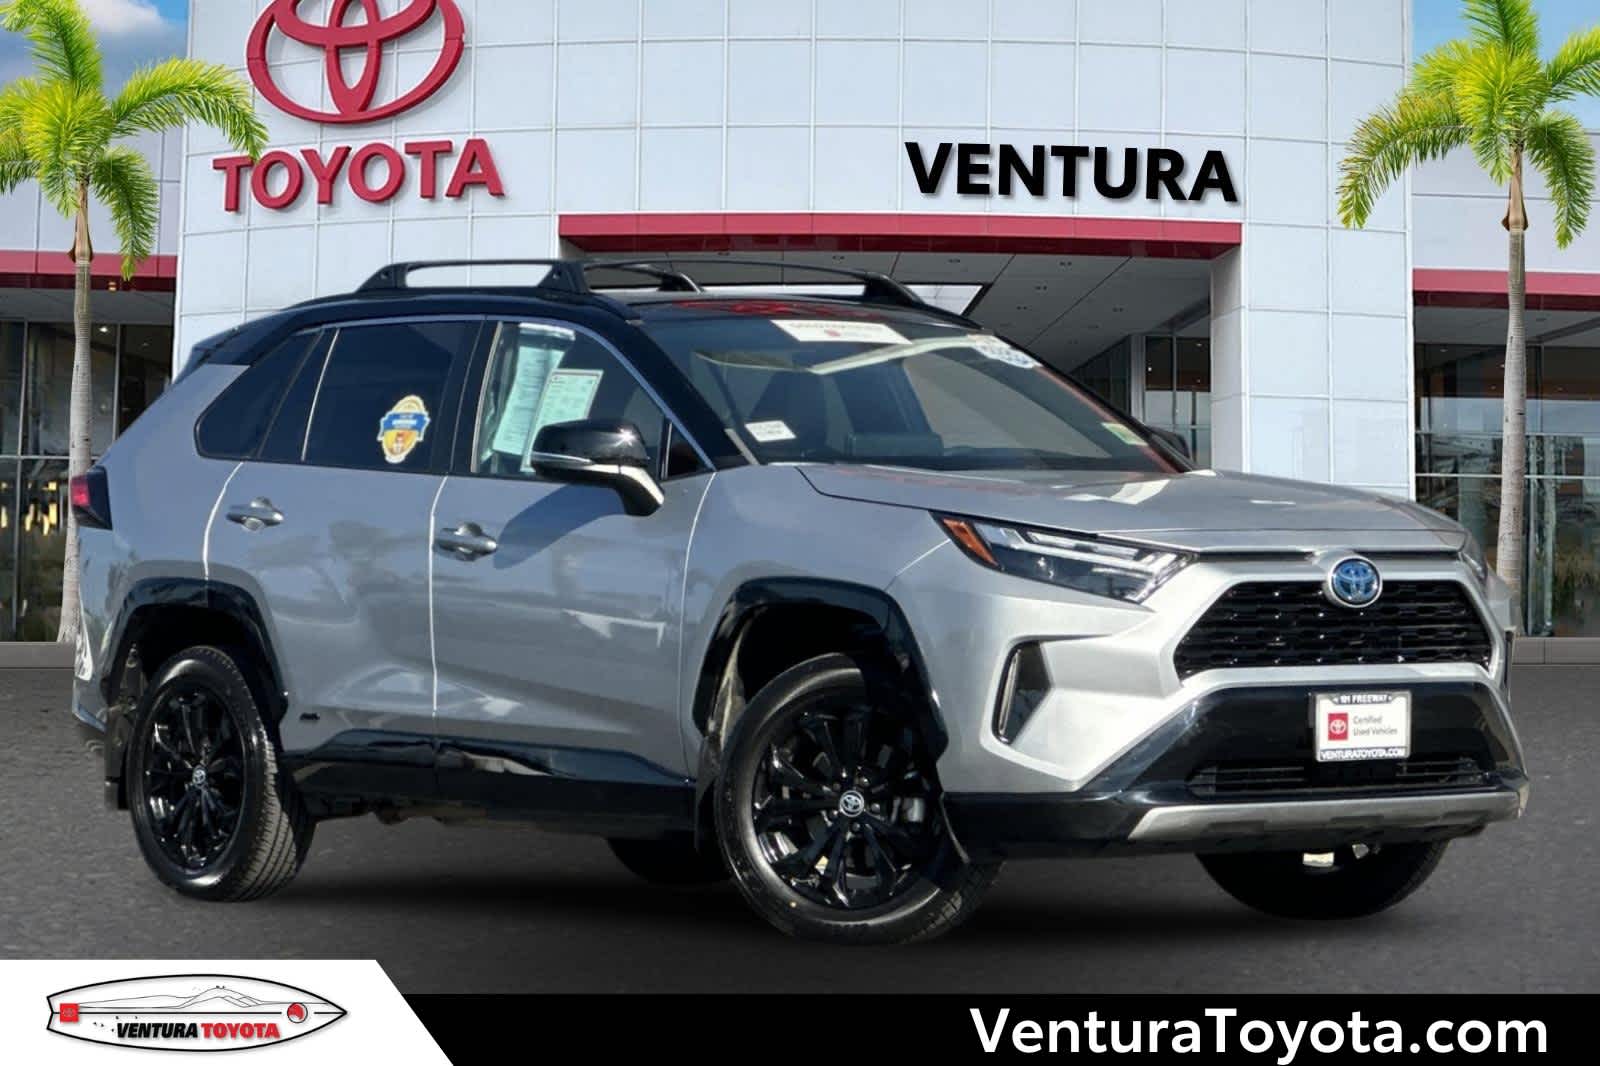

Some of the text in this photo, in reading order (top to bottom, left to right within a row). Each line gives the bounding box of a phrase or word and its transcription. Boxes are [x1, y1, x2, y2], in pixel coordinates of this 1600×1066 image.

[213, 138, 505, 213] TOYOTA
[904, 141, 1238, 202] VENTURA
[1352, 693, 1388, 704] FREEWAY
[1353, 715, 1383, 725] Certified
[1353, 725, 1398, 737] Used Vehicles
